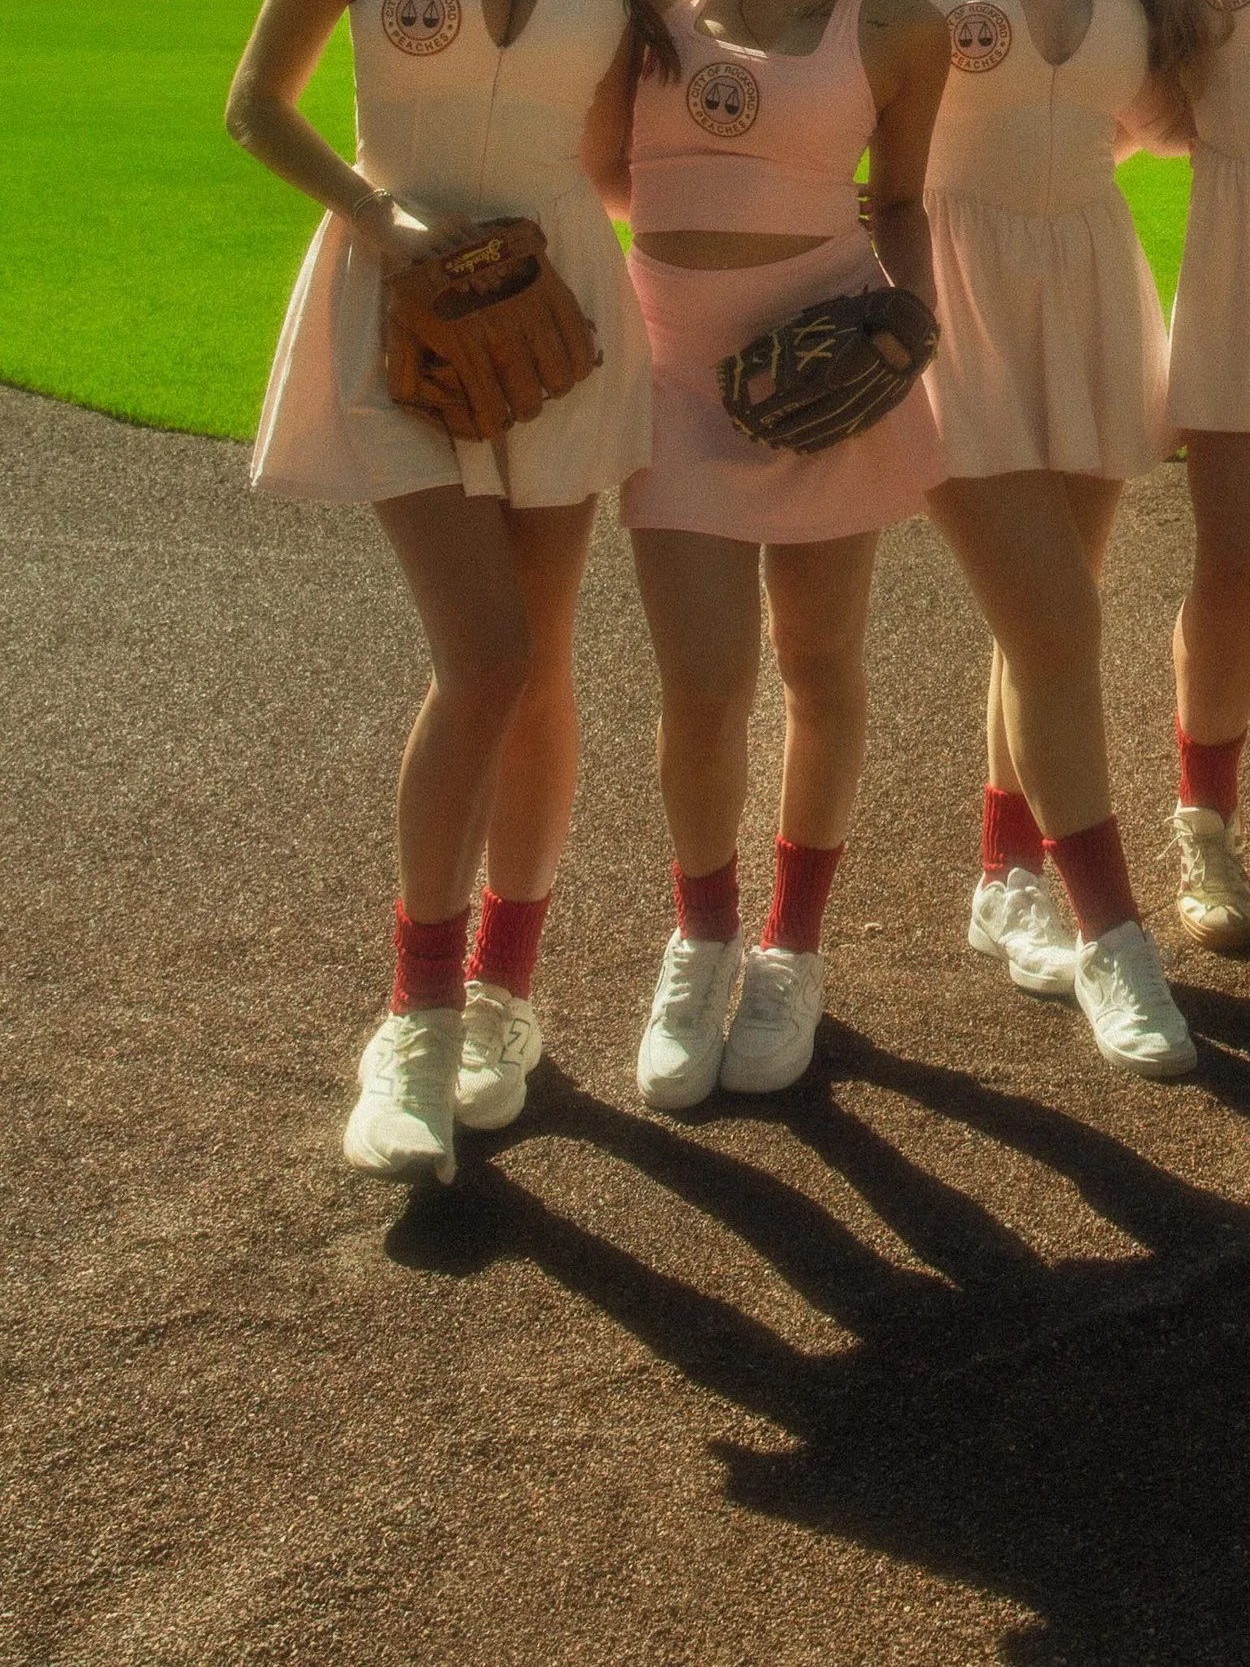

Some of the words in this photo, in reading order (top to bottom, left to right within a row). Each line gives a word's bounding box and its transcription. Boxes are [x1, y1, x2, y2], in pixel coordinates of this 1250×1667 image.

[968, 5, 1007, 38] ROCKFORD
[391, 32, 450, 52] PEACHES
[953, 49, 1002, 69] PEACHES
[690, 74, 707, 99] CITY
[707, 66, 720, 77] OF
[724, 65, 756, 111] ROCKFORD
[694, 110, 747, 134] PEACHES
